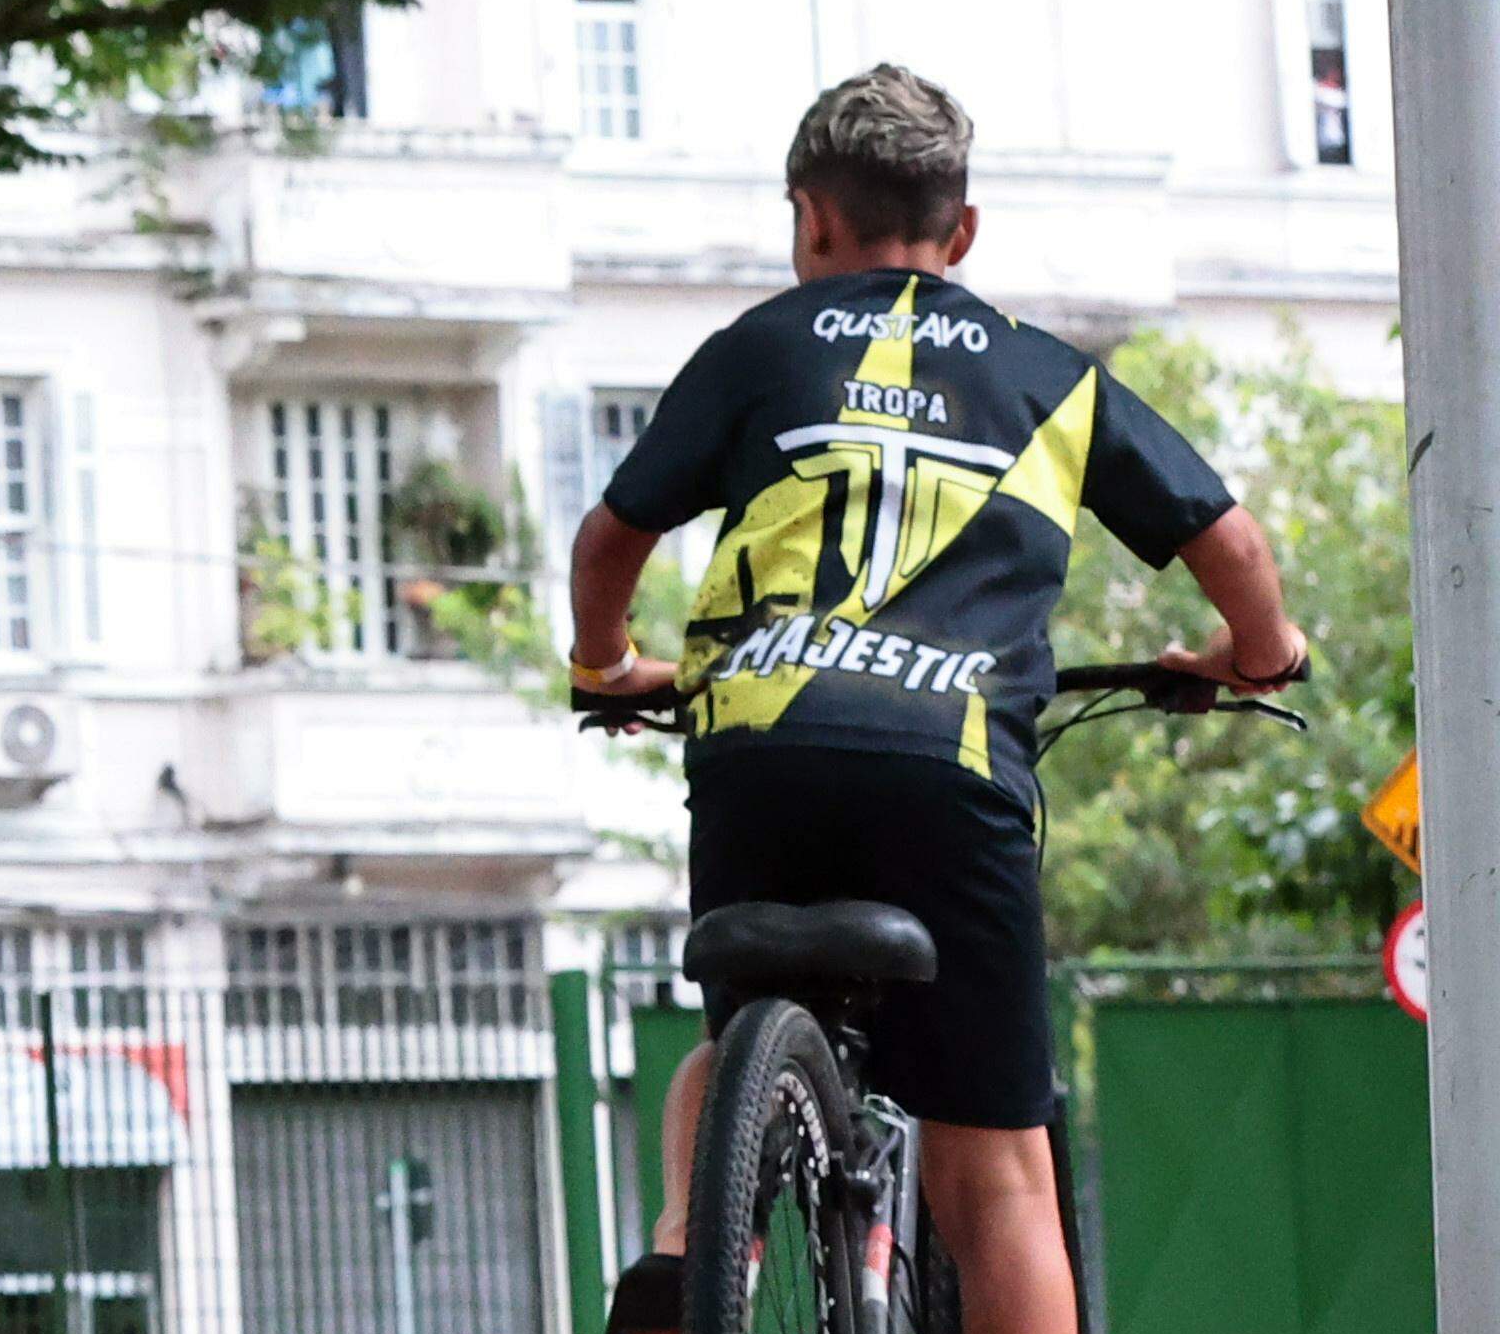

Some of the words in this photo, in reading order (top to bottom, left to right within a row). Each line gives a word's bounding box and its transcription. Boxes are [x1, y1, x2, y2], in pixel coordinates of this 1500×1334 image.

[813, 308, 989, 353] GUSTAVO
[843, 380, 948, 424] TROPA
[717, 614, 997, 694] MAJESTIC
